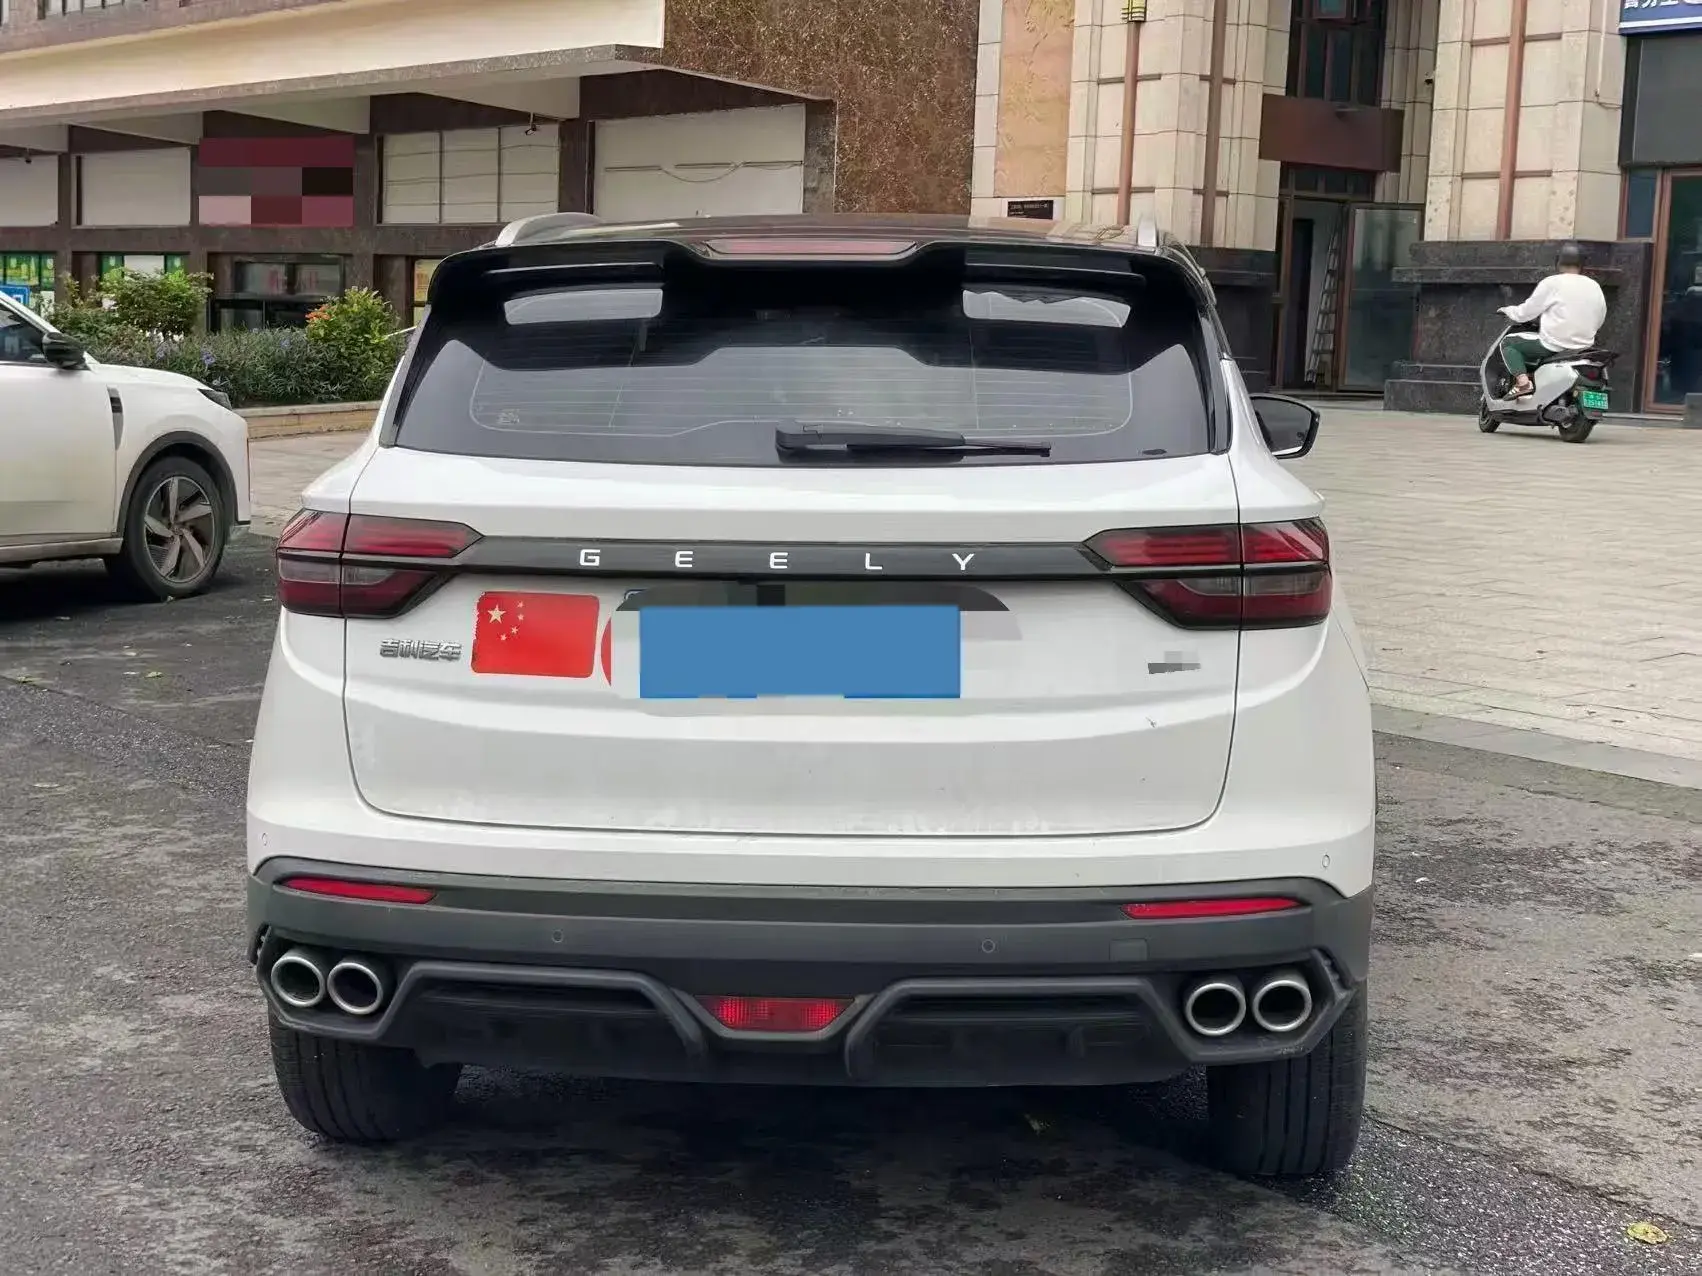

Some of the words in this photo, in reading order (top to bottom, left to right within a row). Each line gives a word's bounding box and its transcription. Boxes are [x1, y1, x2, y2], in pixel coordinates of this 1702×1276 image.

[579, 549, 975, 571] GEELY
[379, 639, 461, 661] 吉利汽车
